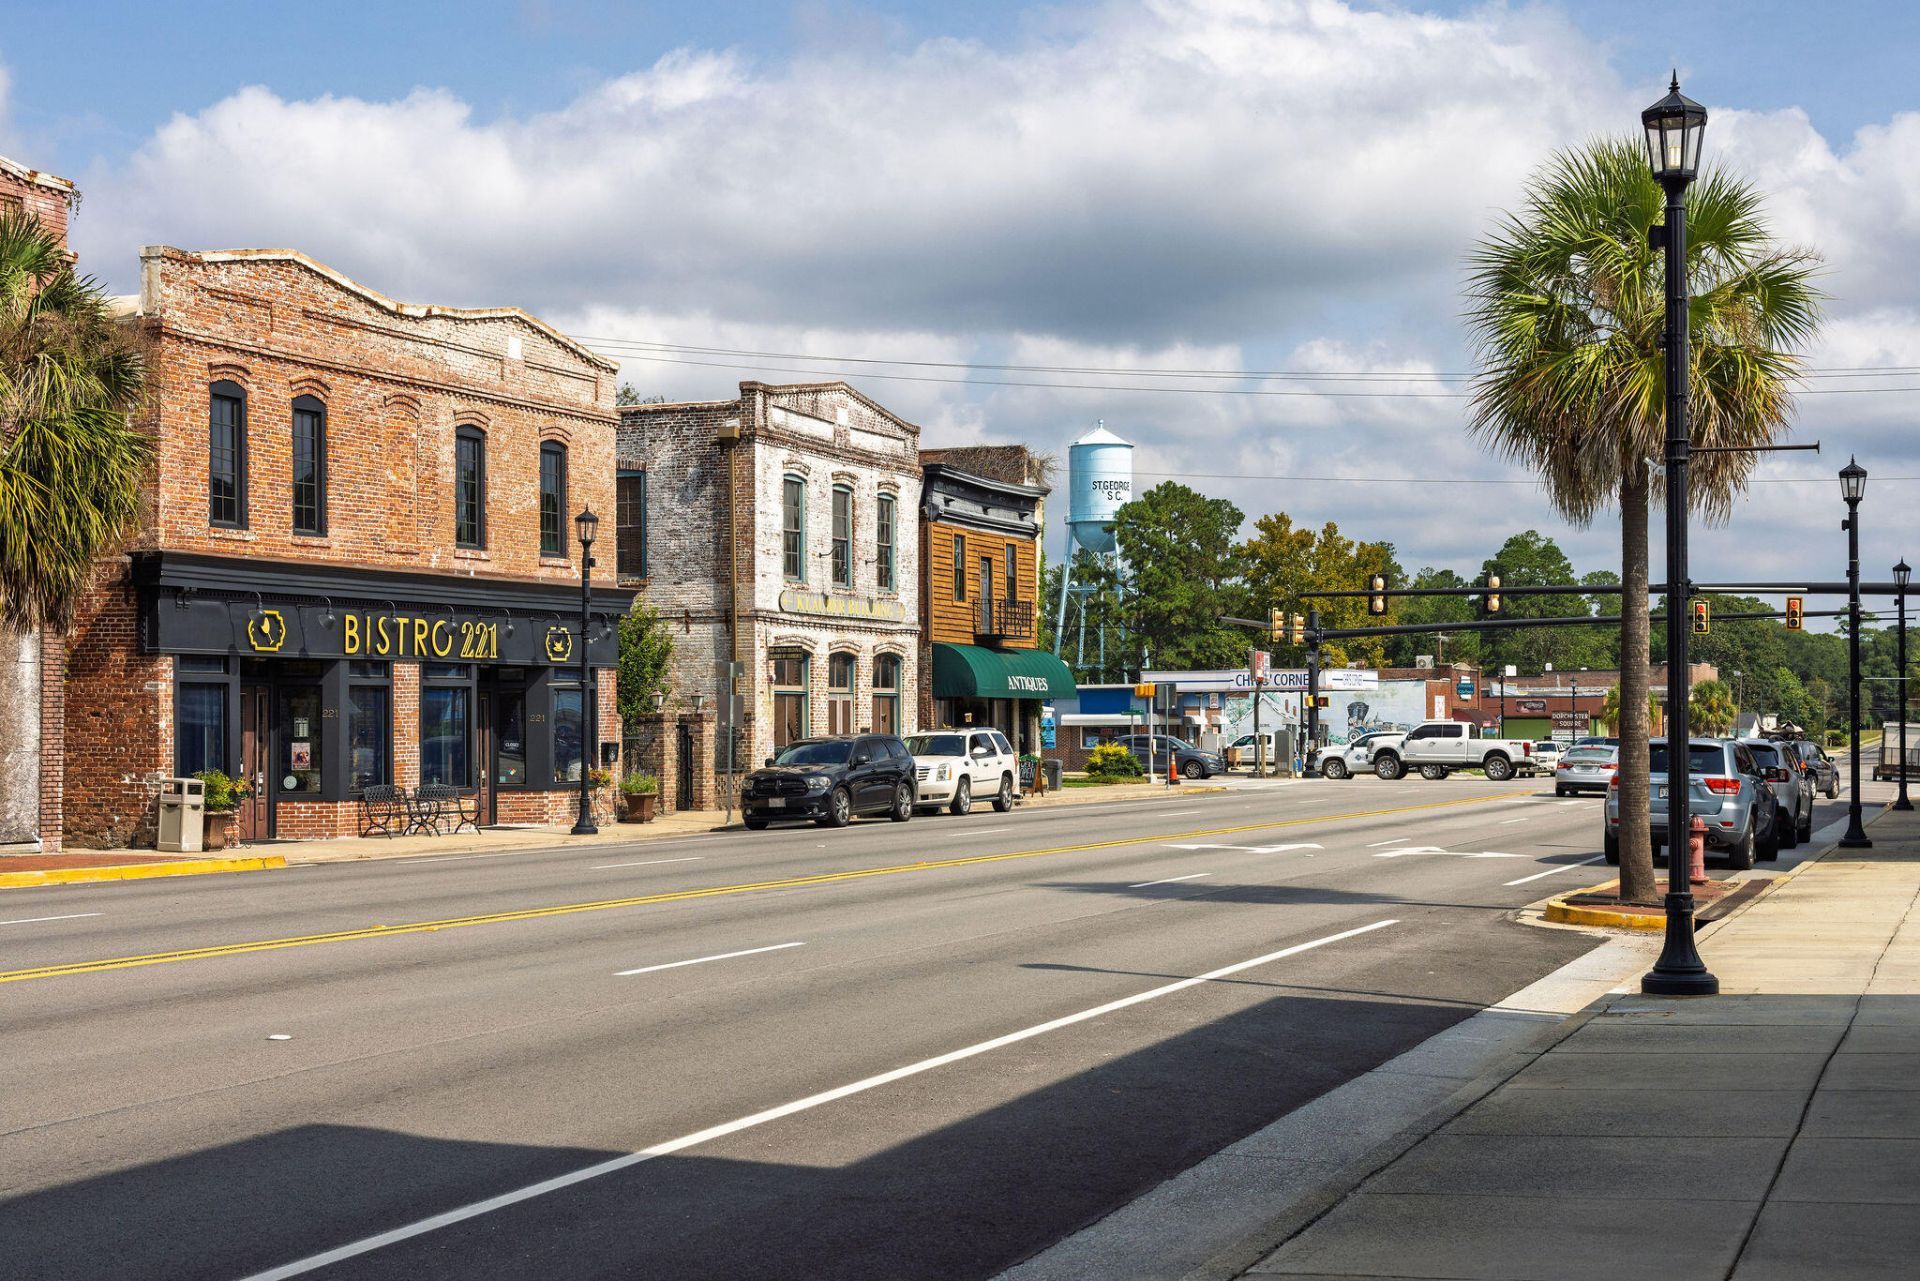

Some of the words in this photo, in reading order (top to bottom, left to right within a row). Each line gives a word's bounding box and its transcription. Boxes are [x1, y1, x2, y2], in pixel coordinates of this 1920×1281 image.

[345, 614, 453, 657] BISTRO
[460, 621, 498, 659] 221
[1008, 675, 1049, 691] ANTIQUES
[1274, 673, 1309, 686] CORNE
[322, 709, 339, 718] 221
[529, 714, 545, 722] 221
